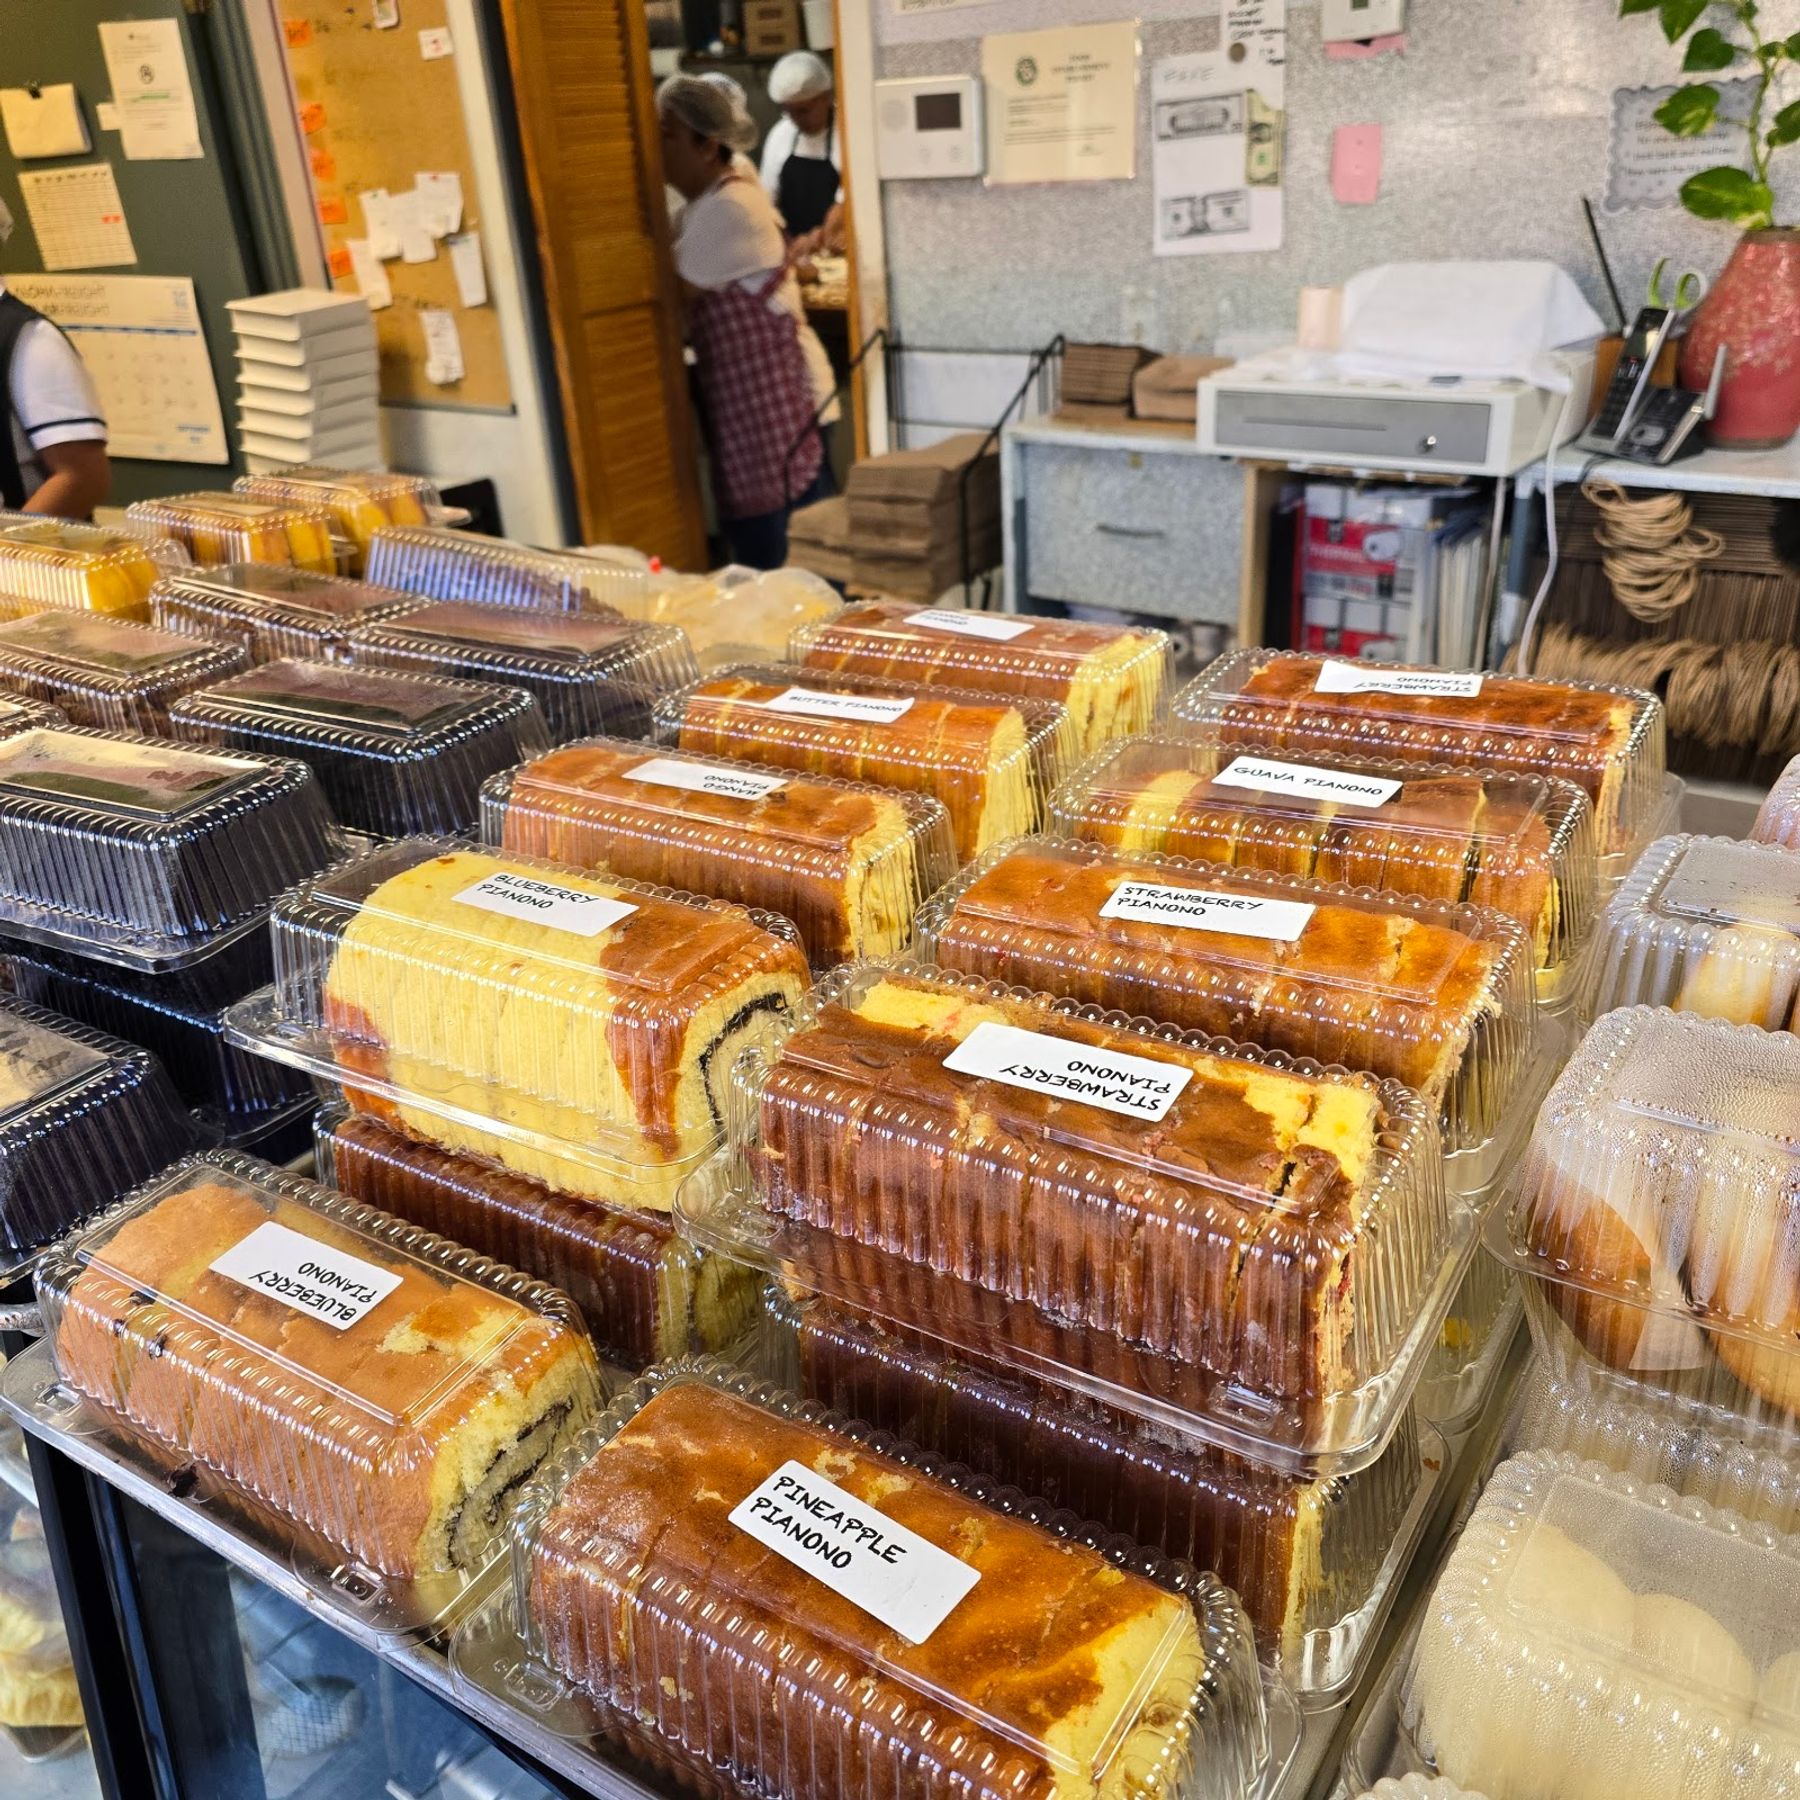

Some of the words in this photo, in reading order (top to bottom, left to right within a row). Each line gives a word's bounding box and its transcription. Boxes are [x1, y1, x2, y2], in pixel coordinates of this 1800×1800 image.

[1354, 682, 1472, 693] STRAWBERRY
[1397, 676, 1473, 686] PIANONO
[789, 696, 838, 707] BUTTER
[844, 702, 902, 713] PIANONO
[703, 783, 762, 796] MANGO
[704, 775, 770, 789] PIANONO
[1233, 766, 1295, 782] GUAVA
[1304, 778, 1383, 796] PIANONO
[476, 884, 554, 909] PIANONO
[493, 874, 600, 904] BLUEBERRY
[1123, 886, 1264, 910] STRAWBERRY
[1117, 897, 1206, 916] PIANONO
[998, 1064, 1162, 1111] STRAWBERRY
[1067, 1060, 1171, 1094] PIANONO
[248, 1270, 357, 1321] BLUEBERRY
[297, 1261, 377, 1303] PIANONO
[749, 1496, 852, 1569] PIANONO
[772, 1475, 907, 1564] PINEAPPLE
